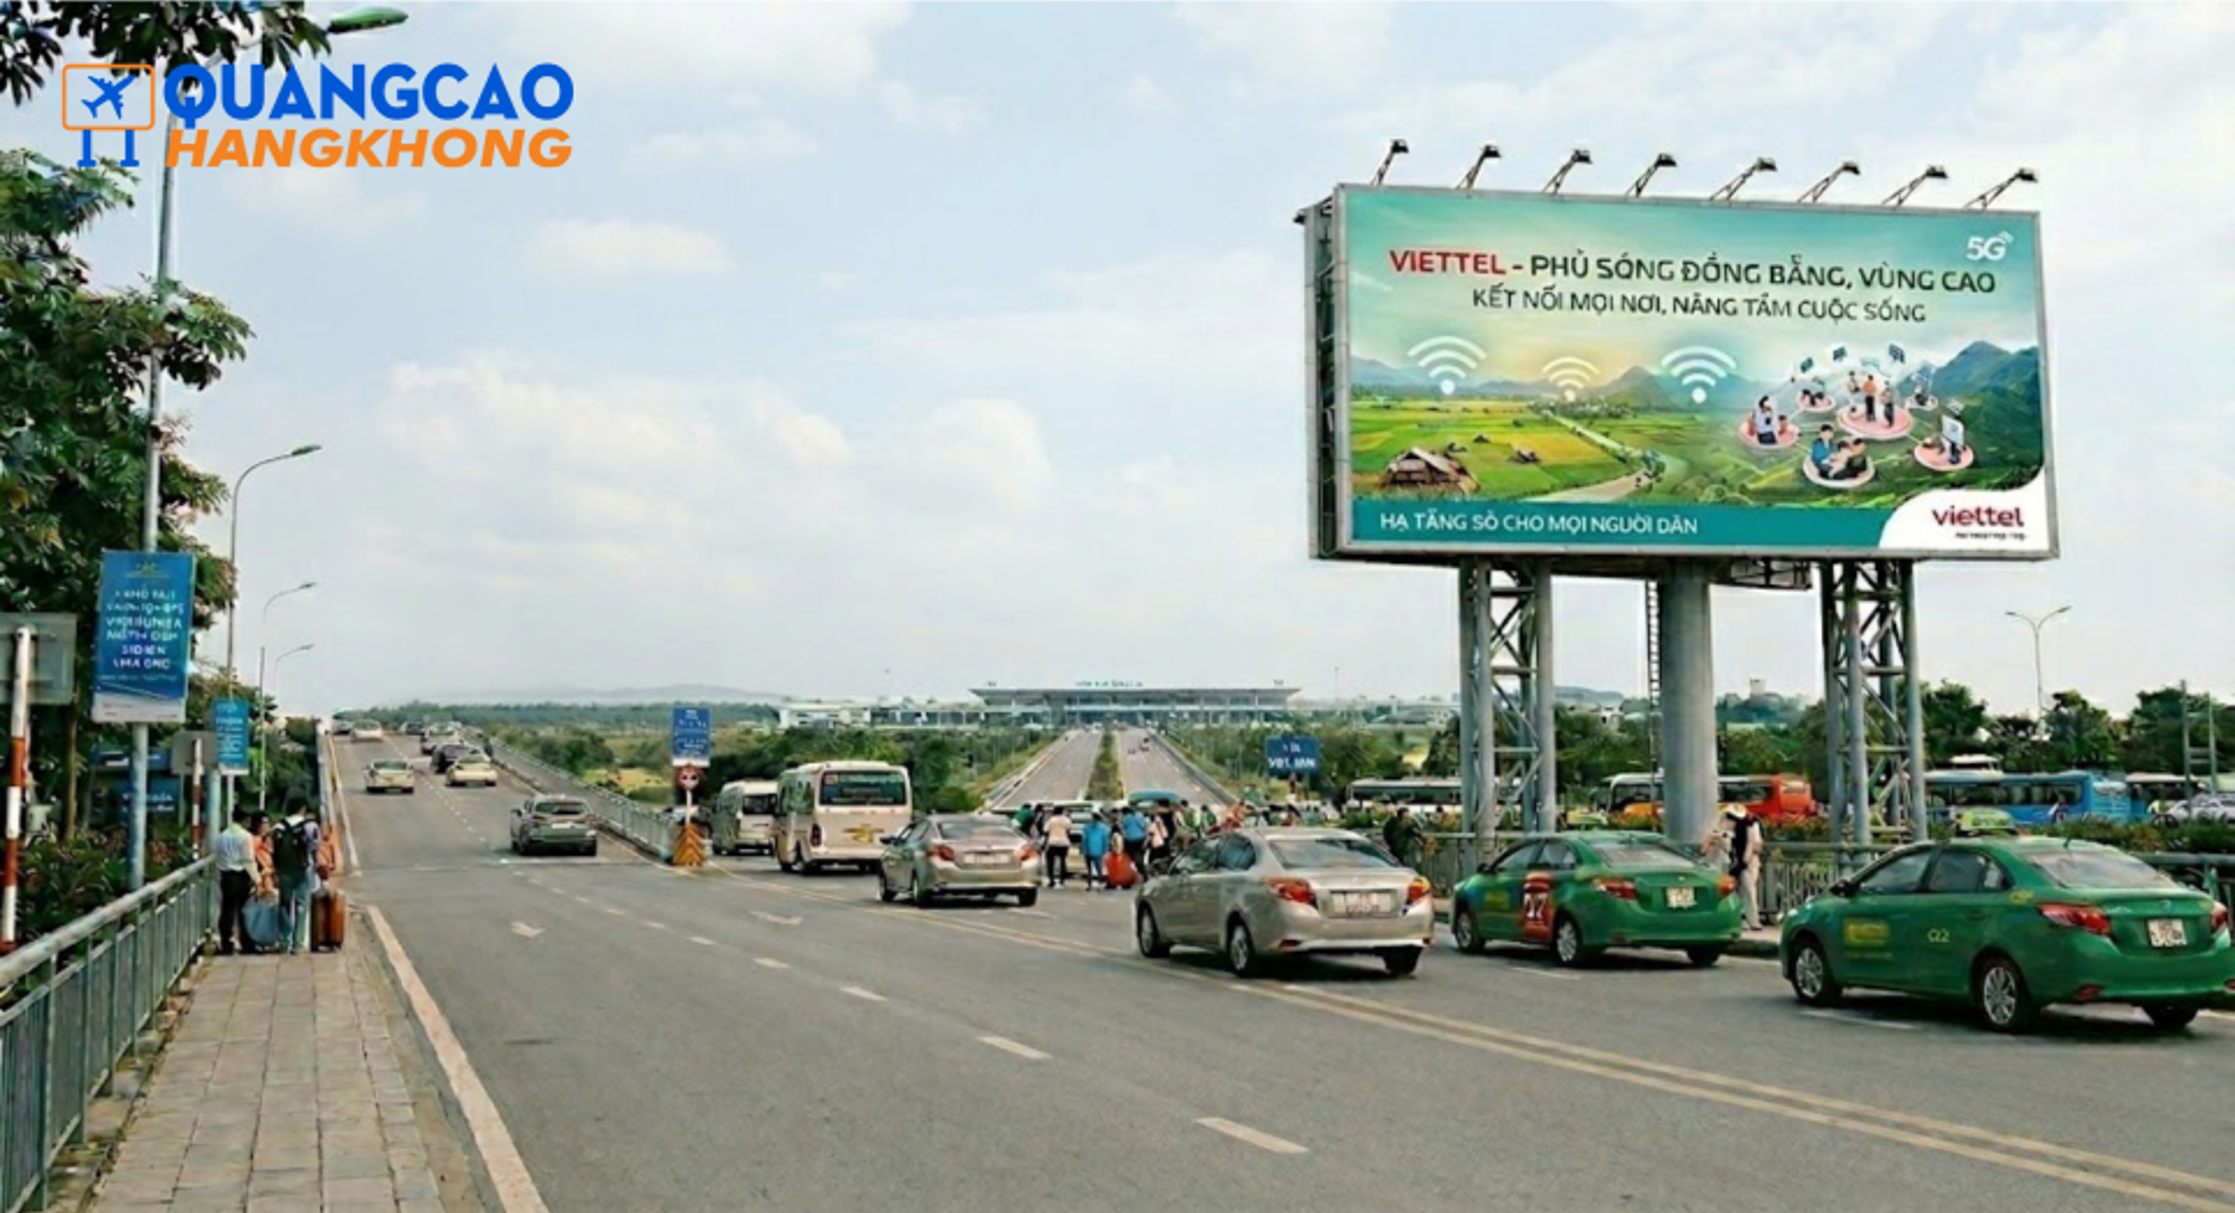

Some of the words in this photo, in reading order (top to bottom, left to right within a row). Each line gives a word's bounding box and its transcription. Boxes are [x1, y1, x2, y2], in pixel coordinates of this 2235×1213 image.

[1966, 235, 2007, 261] 5G
[1389, 249, 1506, 275] VIETTEL
[1530, 248, 1589, 279] PHỦ
[1596, 251, 1676, 282] SÓNG
[1858, 261, 1935, 292] VÙNG
[1941, 270, 1997, 294] CAO
[1472, 281, 1517, 310] KẾT
[1522, 283, 1564, 312] NỐI
[1570, 291, 1614, 316] MỌI
[1621, 293, 1667, 316] NƠI,
[1379, 512, 1409, 532] HẠ
[1502, 514, 1545, 533] CHO
[1548, 515, 1587, 535] MỌI
[1931, 504, 2025, 528] viettel
